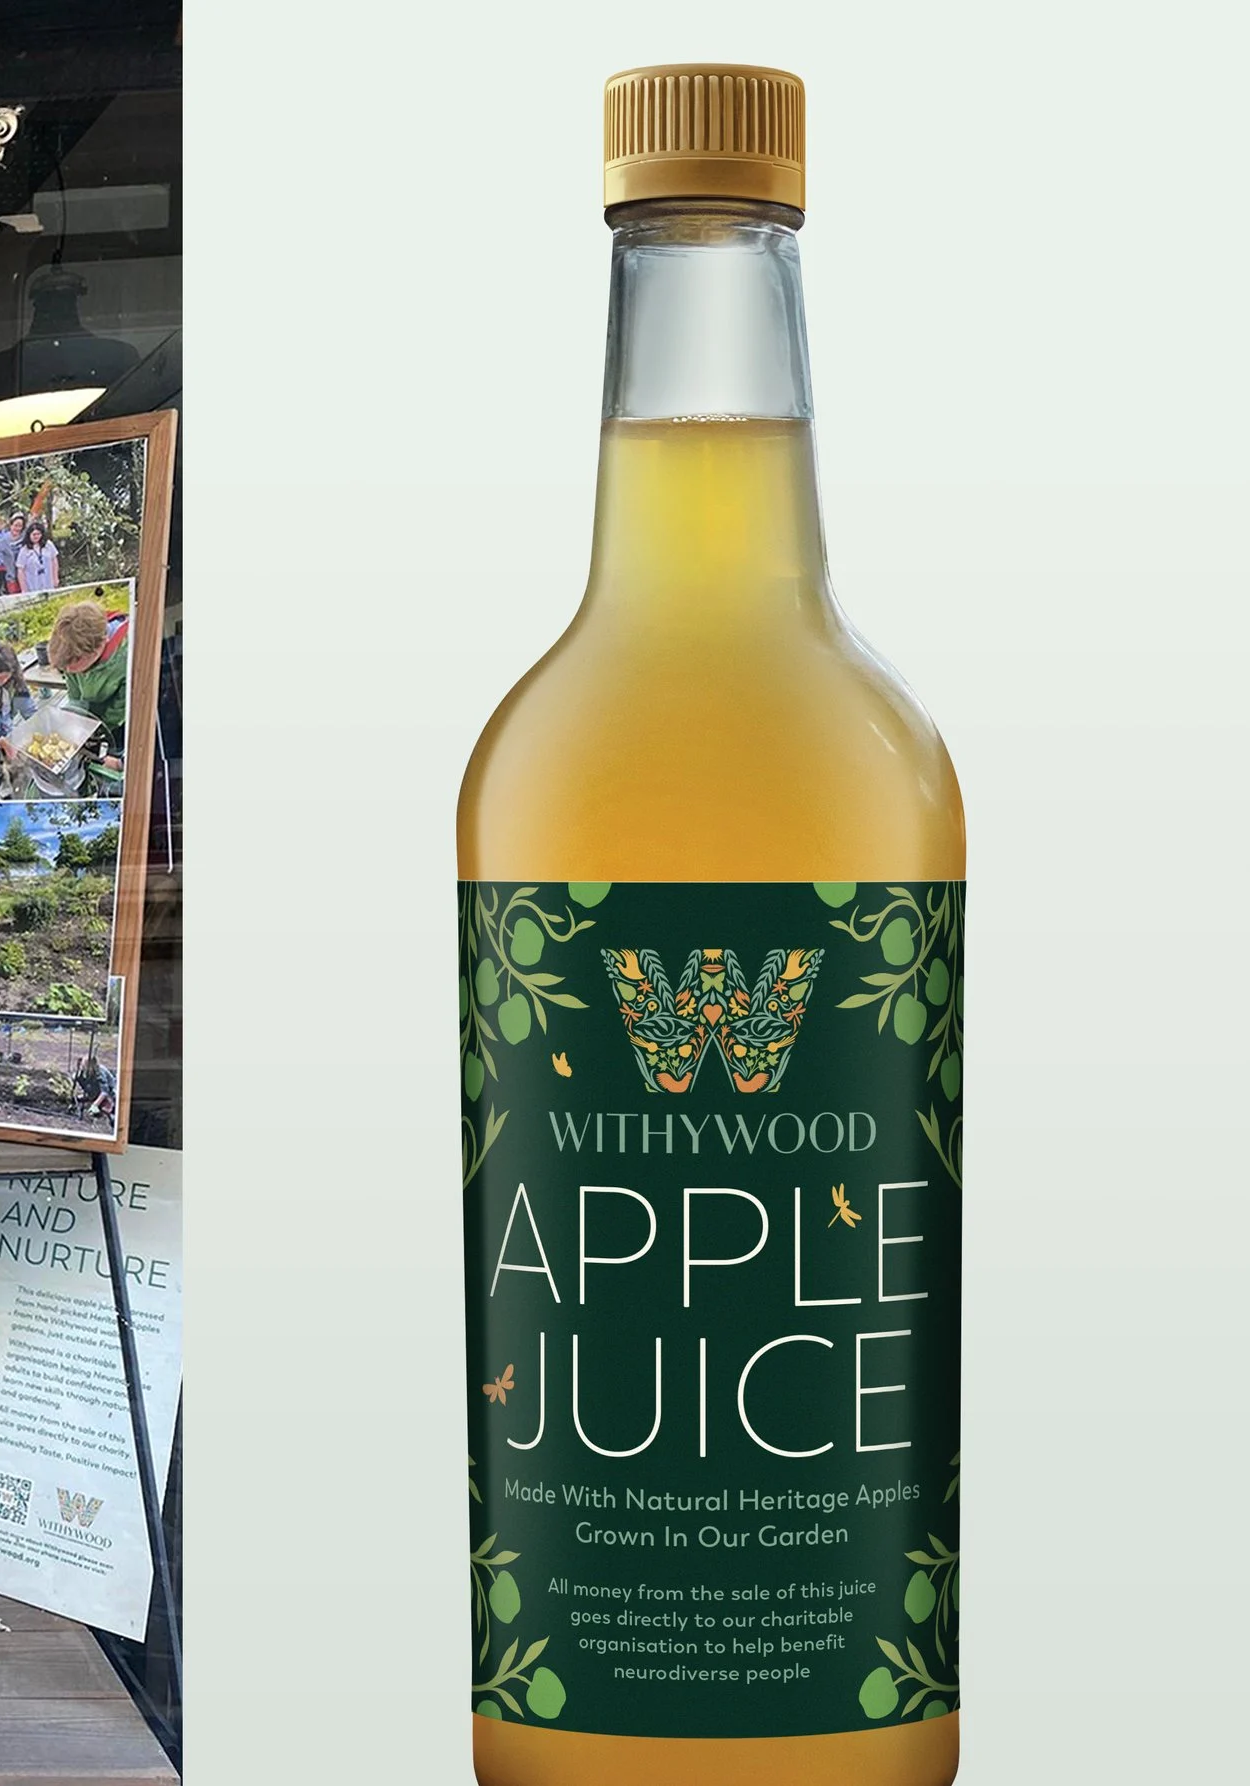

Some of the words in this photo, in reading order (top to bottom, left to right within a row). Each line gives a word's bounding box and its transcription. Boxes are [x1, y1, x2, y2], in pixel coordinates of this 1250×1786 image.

[601, 949, 825, 1092] W
[549, 1111, 877, 1154] WITHYWOOD
[9, 1175, 150, 1210] NATURE
[1, 1201, 75, 1233] AND
[490, 1181, 928, 1307] APPLE
[16, 1298, 35, 1307] from
[37, 1303, 88, 1319] hand-picked
[17, 1285, 34, 1296] This
[36, 1289, 71, 1302] delicious
[73, 1298, 97, 1308] apple
[14, 1309, 33, 1319] from
[35, 1313, 48, 1323] the
[50, 1317, 97, 1334] Withywood
[48, 1330, 63, 1340] just
[65, 1333, 97, 1347] outside
[6, 1351, 58, 1370] organisation
[61, 1361, 91, 1379] helping
[9, 1339, 55, 1356] Withywood
[73, 1351, 116, 1369] charitable
[3, 1375, 23, 1386] learn
[26, 1381, 41, 1390] new
[44, 1383, 64, 1397] skills
[66, 1391, 101, 1405] through
[5, 1365, 30, 1377] adults
[43, 1372, 63, 1384] build
[65, 1378, 111, 1394] confidence
[507, 1330, 911, 1458] JUICE
[1, 1388, 16, 1398] and
[18, 1391, 62, 1409] gardening.
[10, 1409, 37, 1422] money
[40, 1415, 60, 1426] from
[62, 1420, 76, 1431] the
[78, 1425, 96, 1436] sale
[98, 1430, 107, 1438] of
[109, 1433, 126, 1444] this
[17, 1423, 35, 1435] goes
[38, 1426, 68, 1442] directly
[71, 1435, 80, 1444] to
[82, 1440, 96, 1449] our
[98, 1444, 131, 1459] charity.
[39, 1445, 64, 1461] Taste,
[66, 1452, 99, 1469] Positive
[102, 1462, 137, 1480] Impact!
[505, 1478, 556, 1505] Made
[562, 1484, 616, 1509] With
[627, 1489, 728, 1511] Natural
[740, 1488, 849, 1513] Heritage
[856, 1481, 920, 1509] Apples
[38, 1518, 112, 1549] WITHYWOOD
[576, 1522, 654, 1546] Grown
[665, 1527, 687, 1547] In
[699, 1526, 749, 1547] Our
[758, 1524, 848, 1547] Garden
[548, 1579, 568, 1595] All
[574, 1584, 631, 1603] money
[638, 1584, 683, 1600] from
[690, 1586, 724, 1602] the
[731, 1585, 770, 1601] sale
[776, 1584, 796, 1600] of
[801, 1581, 834, 1598] this
[839, 1580, 876, 1600] juice
[571, 1610, 610, 1626] goes
[617, 1611, 687, 1631] directly
[694, 1613, 716, 1628] to
[722, 1615, 755, 1628] our
[761, 1608, 853, 1627] charitable
[579, 1636, 698, 1655] organisation
[704, 1640, 725, 1654] to
[733, 1638, 774, 1657] help
[781, 1634, 845, 1653] benefit
[614, 1665, 739, 1681] neurodiverse
[747, 1663, 810, 1684] people
